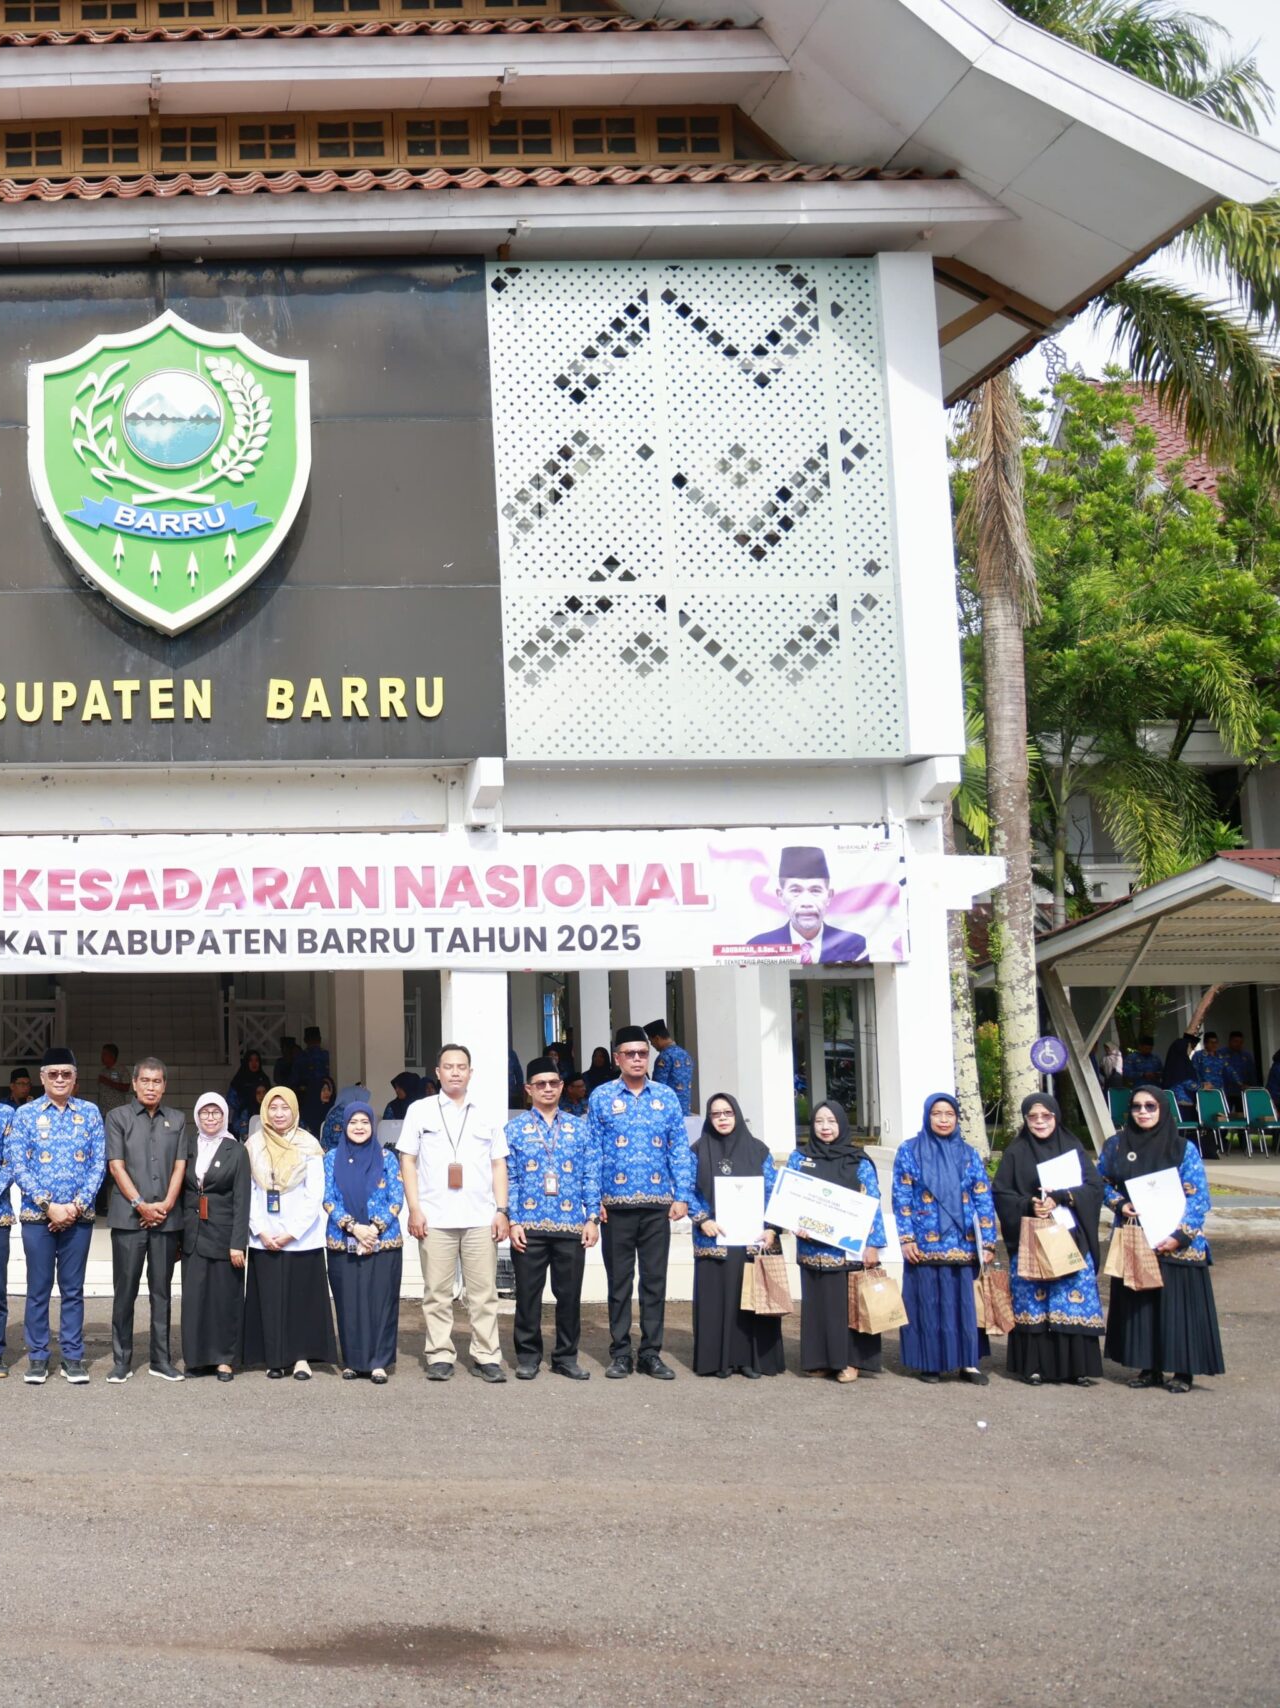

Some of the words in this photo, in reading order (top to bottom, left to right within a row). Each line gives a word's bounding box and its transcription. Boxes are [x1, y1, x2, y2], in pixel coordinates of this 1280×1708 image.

[112, 506, 227, 534] BARRU
[266, 676, 444, 719] BARRU
[1, 866, 380, 911] KESADARAN
[394, 862, 709, 909] NASIONAL
[77, 927, 287, 955] KABUPATEN
[297, 926, 416, 953] BARRU
[424, 925, 548, 953] TAHUN
[556, 923, 642, 951] 2025
